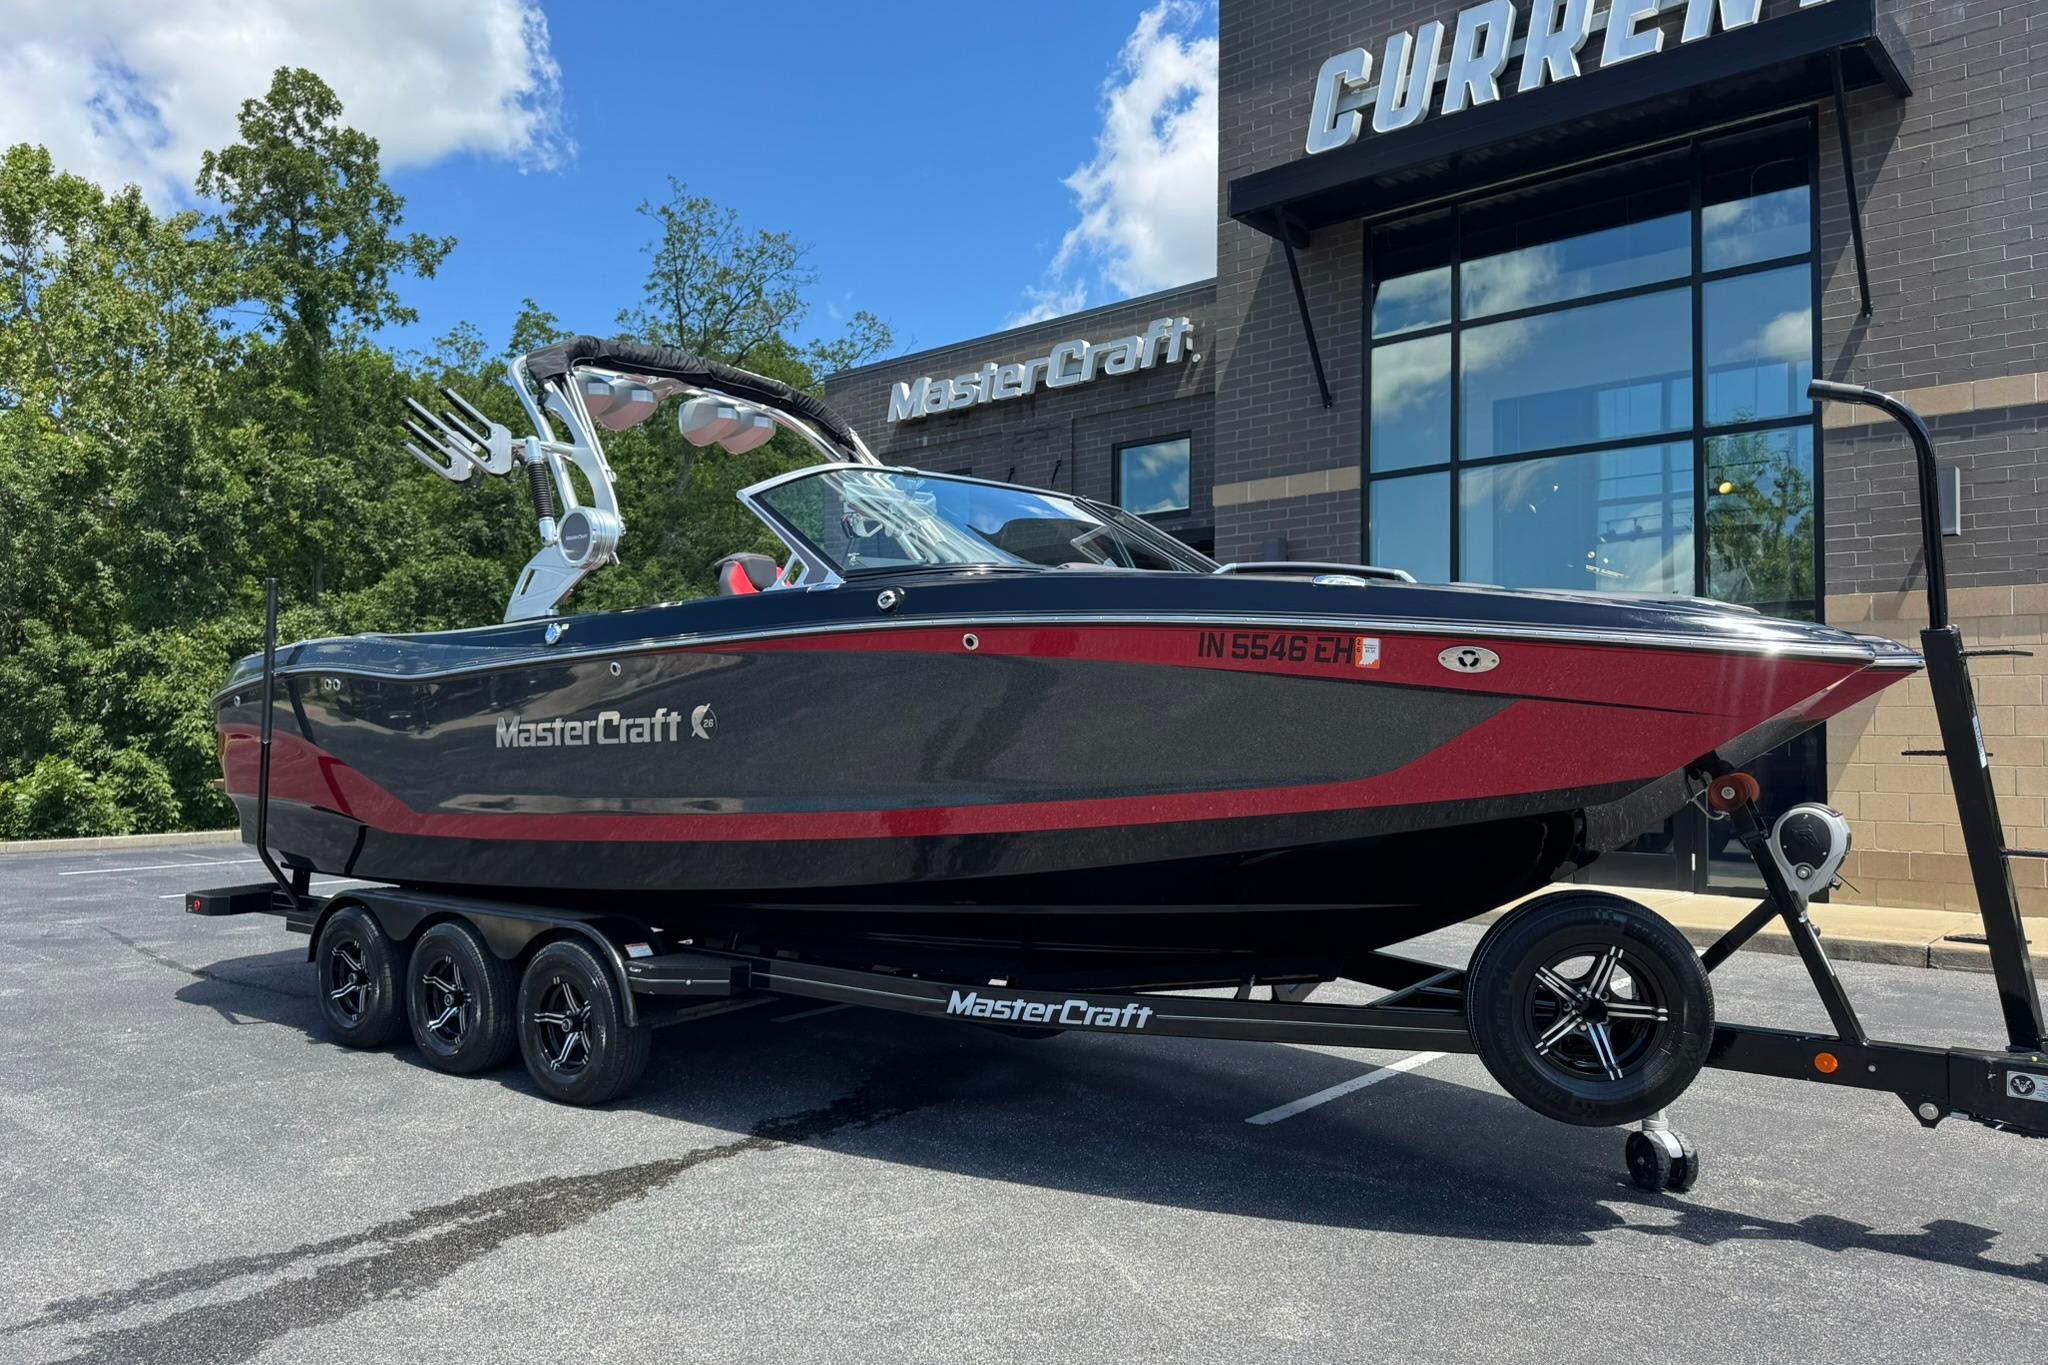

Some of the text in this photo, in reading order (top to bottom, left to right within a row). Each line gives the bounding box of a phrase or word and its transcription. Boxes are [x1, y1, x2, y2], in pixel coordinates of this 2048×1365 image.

[1305, 0, 1830, 154] CURRE
[887, 316, 1194, 423] MasterCraft
[1198, 631, 1355, 665] IN 5546 EH
[496, 707, 714, 748] MasterCraft 26
[946, 990, 1153, 1029] MasterCraft
